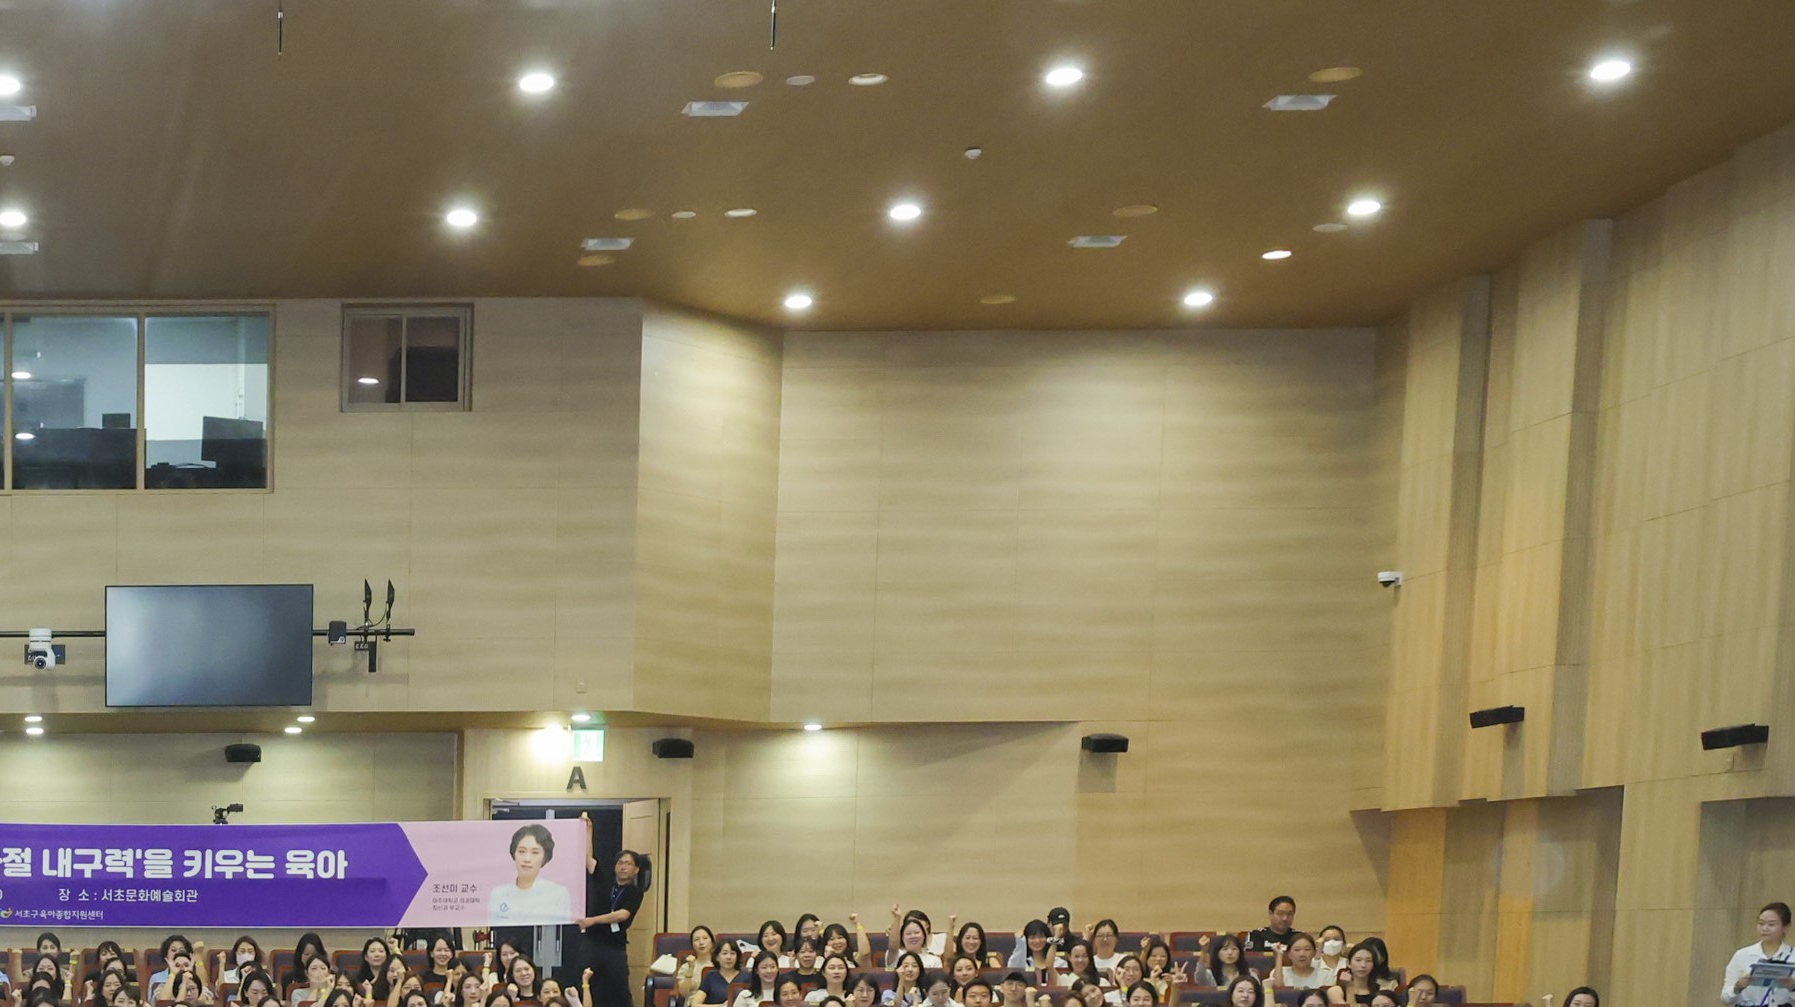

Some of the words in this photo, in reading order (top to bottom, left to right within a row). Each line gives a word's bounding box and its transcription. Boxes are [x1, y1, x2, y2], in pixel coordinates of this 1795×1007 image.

[567, 766, 587, 790] A
[42, 847, 174, 879] 내구력'을
[183, 848, 275, 880] 키우는
[285, 849, 348, 880] 육아
[58, 888, 71, 902] 장
[102, 888, 199, 903] 서초문화예술회관
[432, 884, 458, 893] 조선미
[461, 884, 477, 894] 교수
[14, 909, 103, 920] 서초구육아종합지원센터
